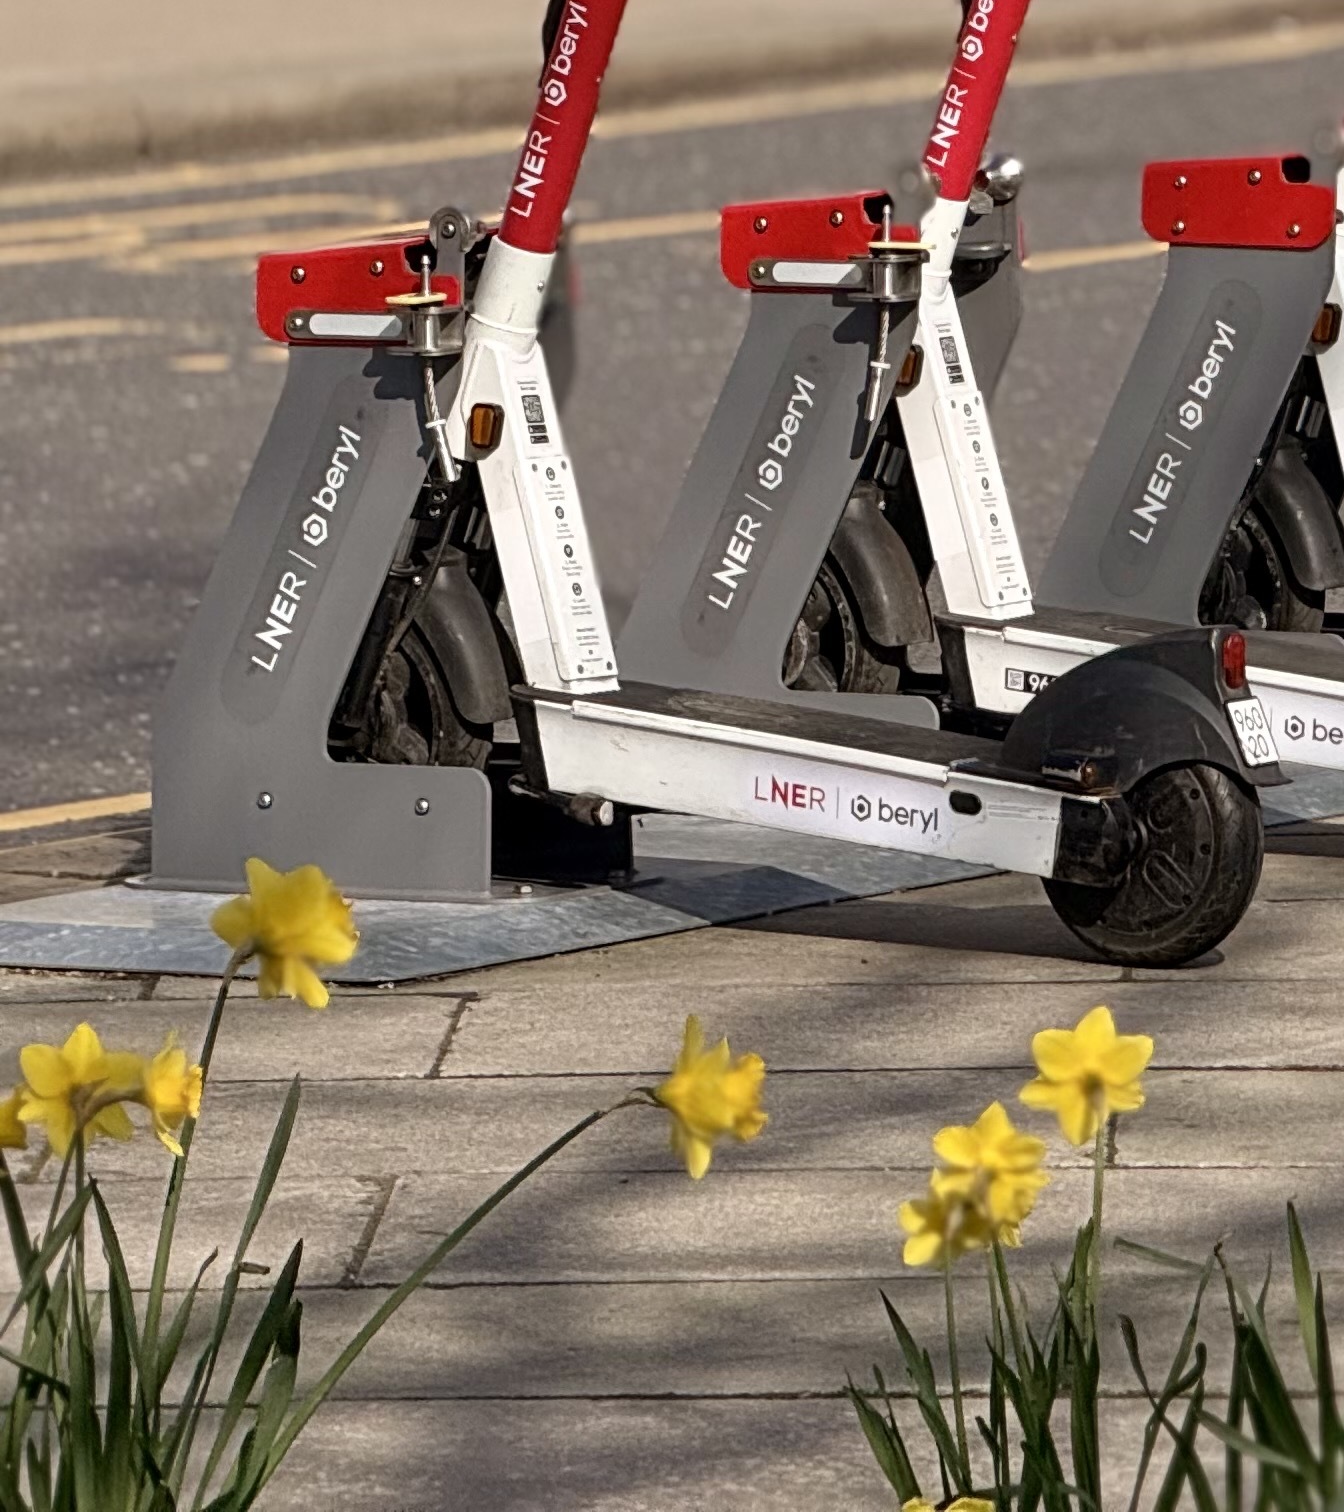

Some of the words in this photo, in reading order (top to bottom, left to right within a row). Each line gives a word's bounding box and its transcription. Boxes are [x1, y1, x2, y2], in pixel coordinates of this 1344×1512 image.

[511, 129, 550, 219] LNER
[552, 2, 588, 76] beryl
[926, 84, 968, 168] LNER
[708, 512, 763, 610] LNER
[767, 374, 816, 460] beryl
[1130, 452, 1183, 544] LNER
[1189, 320, 1235, 399] beryl
[252, 568, 306, 672] LNER
[316, 424, 361, 513] beryl
[1234, 707, 1263, 732] 960
[1248, 734, 1269, 758] 20
[755, 775, 825, 812] LNER
[878, 804, 939, 832] beryl
